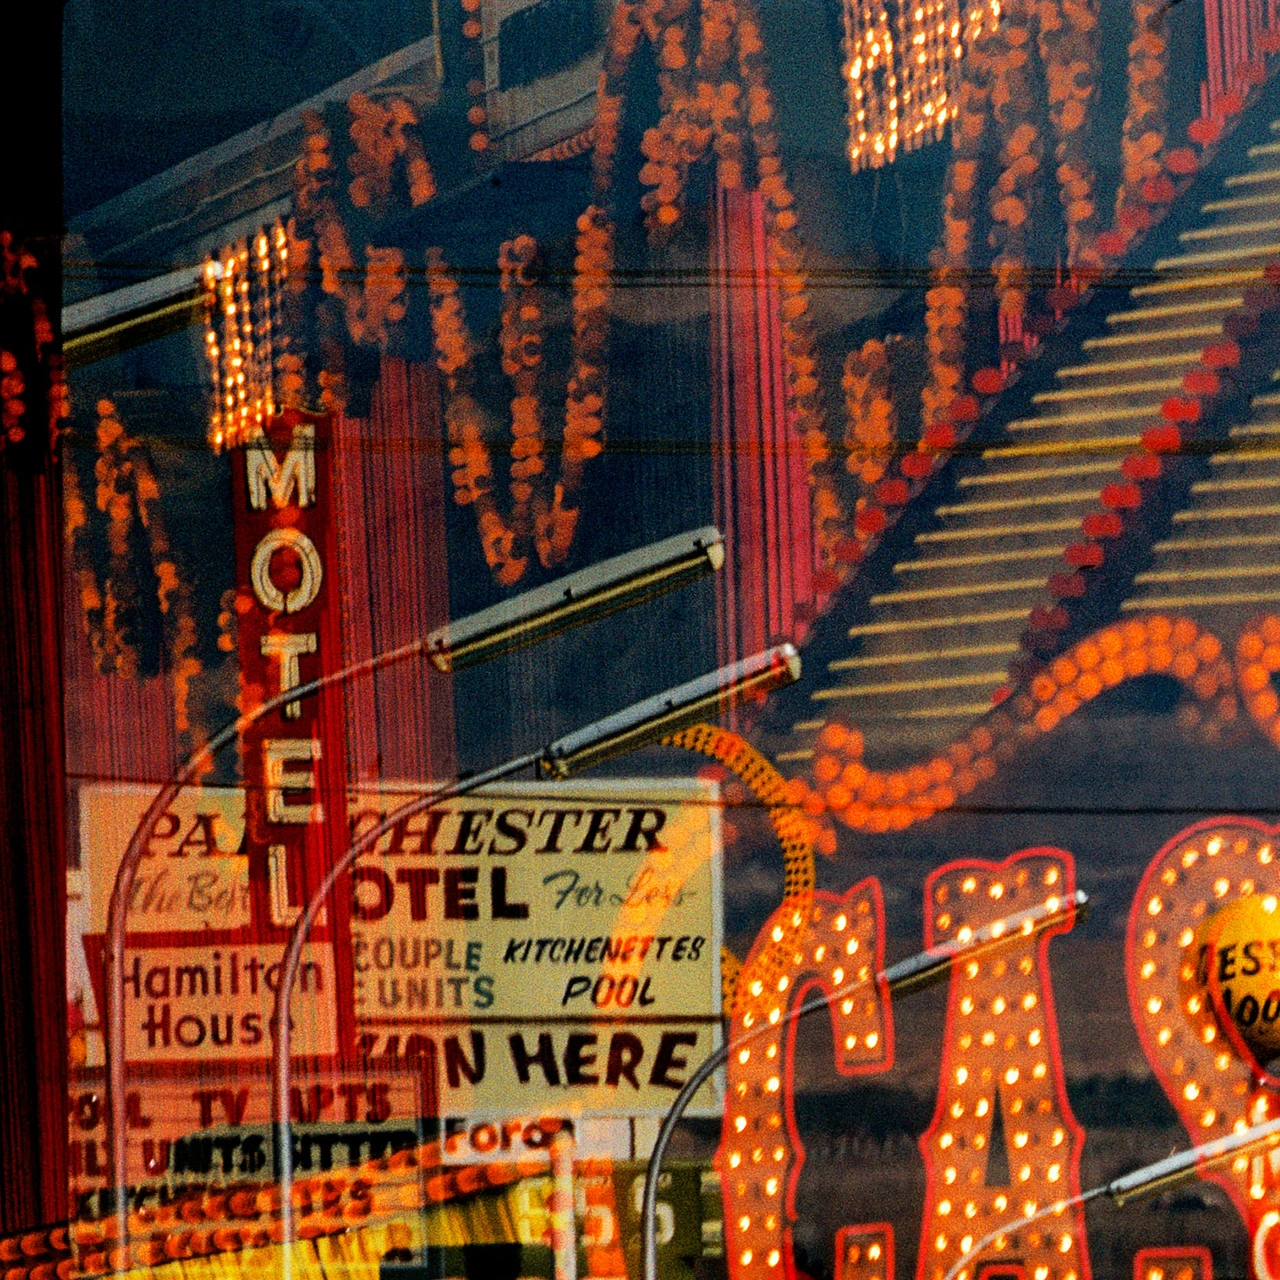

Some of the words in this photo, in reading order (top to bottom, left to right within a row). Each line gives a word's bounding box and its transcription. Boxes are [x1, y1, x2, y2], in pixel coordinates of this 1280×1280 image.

[245, 424, 326, 928] MOTEL
[141, 808, 668, 857] PACHESTER
[353, 866, 530, 922] OTEL
[503, 935, 706, 963] KITCHENETTES
[123, 951, 322, 1000] Hamilton
[377, 974, 495, 1009] UNITS
[562, 973, 656, 1009] POOL
[509, 1029, 698, 1091] HERE
